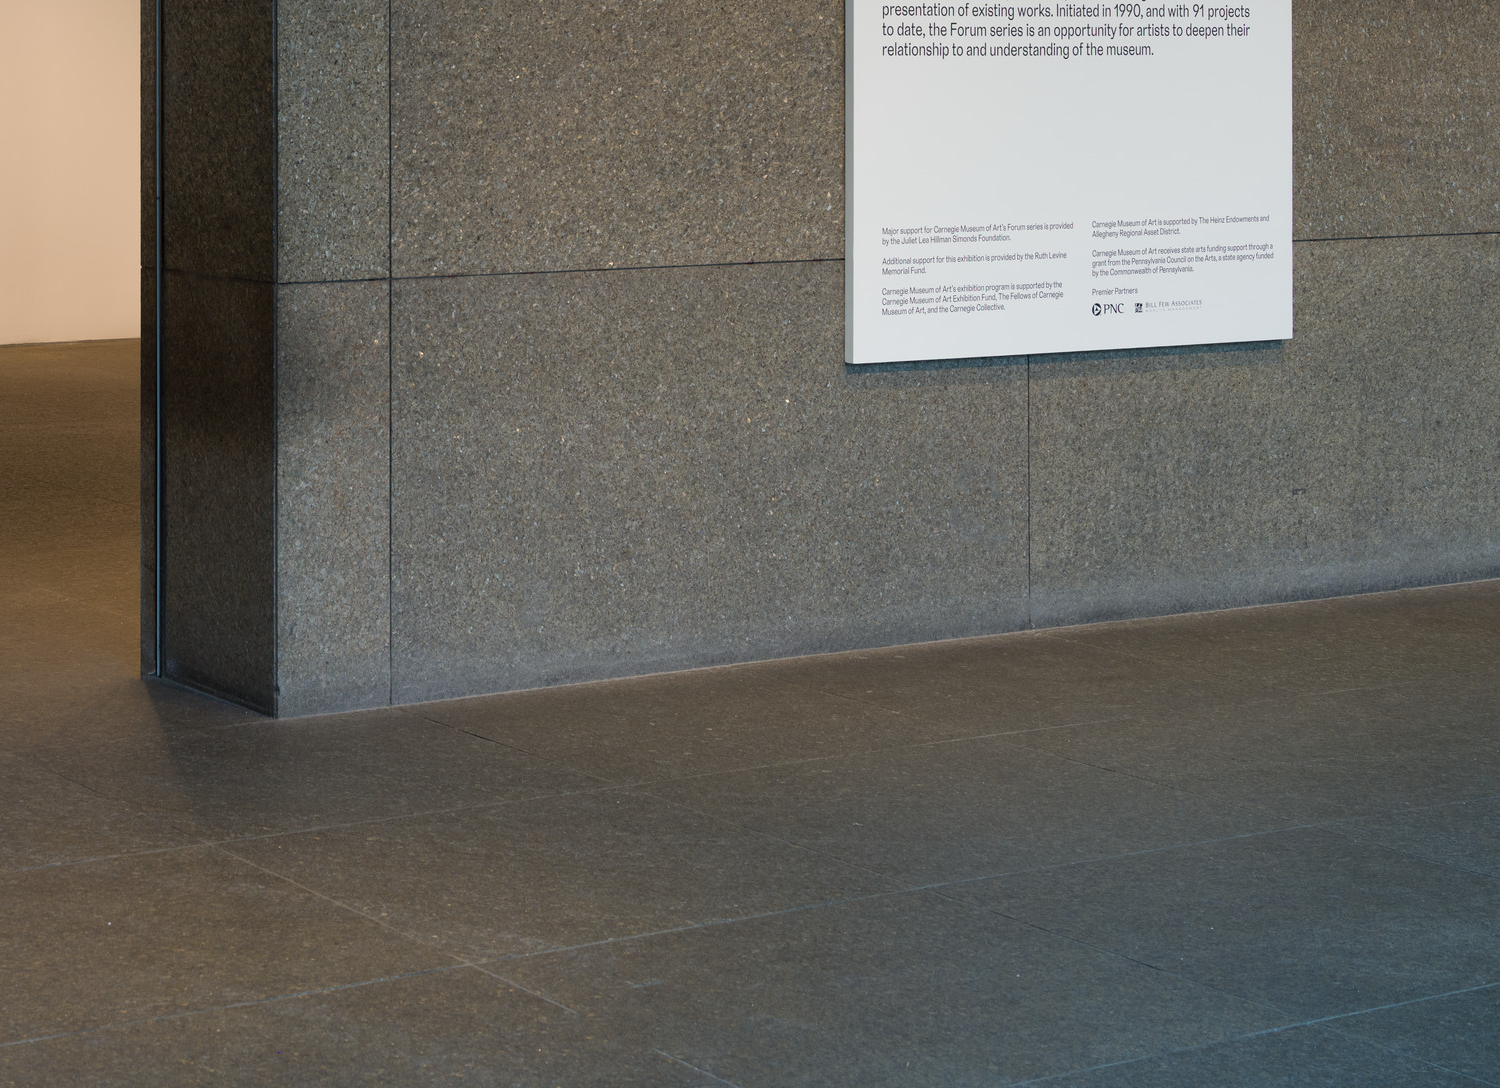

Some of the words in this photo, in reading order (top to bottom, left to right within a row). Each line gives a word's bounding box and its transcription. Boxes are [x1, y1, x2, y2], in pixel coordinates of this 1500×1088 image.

[882, 3, 955, 19] presentation
[957, 2, 970, 17] of
[972, 3, 1015, 21] existing
[1017, 3, 1054, 17] works.
[1056, 3, 1100, 18] Initiated
[1102, 4, 1112, 17] in
[1114, 3, 1144, 20] 1990,
[1146, 4, 1165, 18] and
[1167, 4, 1190, 18] with
[1192, 4, 1204, 18] 91
[1208, 5, 1250, 21] projects
[882, 23, 894, 36] to
[897, 22, 926, 39] date,
[928, 22, 947, 37] the
[950, 22, 987, 37] Forum
[990, 23, 1024, 37] series
[1026, 23, 1035, 37] is
[1037, 26, 1051, 37] an
[1053, 23, 1117, 40] opportunity
[1118, 23, 1134, 37] for
[1136, 23, 1170, 37] artists
[1172, 24, 1183, 37] to
[1185, 23, 1224, 40] deepen
[1226, 23, 1251, 37] their
[882, 42, 950, 60] relationship
[952, 43, 964, 57] to
[966, 42, 987, 57] and
[990, 42, 1070, 60] understanding
[1072, 42, 1084, 56] of
[1086, 42, 1104, 56] the
[1106, 45, 1154, 56] museum.
[1092, 220, 1117, 229] Carnegie
[1141, 219, 1148, 227] of
[1163, 218, 1191, 226] supported
[1191, 218, 1198, 226] by
[1199, 216, 1209, 224] The
[1226, 215, 1259, 224] Endowments
[1260, 214, 1270, 222] and
[882, 227, 899, 236] Major
[900, 227, 923, 236] support
[924, 226, 933, 234] for
[933, 225, 960, 235] Carnegie
[960, 225, 985, 233] Museum
[986, 224, 992, 232] of
[1007, 223, 1026, 231] Forum
[1049, 222, 1074, 231] provided
[1092, 230, 1119, 239] Allegheny
[1119, 229, 1143, 238] Regional
[1143, 228, 1159, 236] Asset
[1160, 227, 1181, 236] District.
[882, 238, 890, 246] by
[890, 237, 900, 245] the
[901, 237, 917, 245] Juliet
[918, 236, 929, 244] Lea
[952, 235, 977, 243] Simonds
[978, 234, 1011, 242] Foundation.
[1092, 249, 1117, 258] Carnegie
[1141, 247, 1148, 256] of
[1148, 247, 1157, 255] Art
[1158, 247, 1181, 255] receives
[1181, 246, 1195, 254] state
[1207, 245, 1227, 254] funding
[1227, 244, 1248, 252] support
[1248, 243, 1269, 252] through
[882, 257, 912, 265] Additional
[912, 256, 935, 265] support
[957, 255, 985, 263] exhibition
[991, 253, 1016, 262] provided
[1016, 253, 1024, 262] by
[1034, 252, 1048, 260] Ruth
[882, 267, 910, 276] Memorial
[910, 266, 927, 274] Fund.
[882, 287, 909, 296] Carnegie
[935, 285, 942, 294] of
[957, 284, 985, 293] exhibition
[985, 284, 1010, 293] program
[1016, 281, 1045, 291] supported
[1046, 281, 1053, 290] by
[1092, 288, 1114, 296] Premier
[1114, 287, 1138, 295] Partners
[882, 298, 909, 306] Carnegie
[935, 295, 942, 304] of
[942, 295, 952, 303] Art
[953, 294, 981, 303] Exhibition
[981, 293, 997, 301] Fund,
[998, 292, 1010, 301] The
[1010, 292, 1031, 300] Fellows
[1032, 291, 1038, 299] of
[1039, 291, 1064, 300] Carnegie
[882, 308, 907, 316] Museum
[908, 307, 915, 315] of
[915, 306, 927, 314] Art,
[927, 306, 938, 314] and
[949, 304, 976, 314] Carnegie
[976, 303, 1005, 312] Collective.
[1103, 303, 1124, 314] PNC
